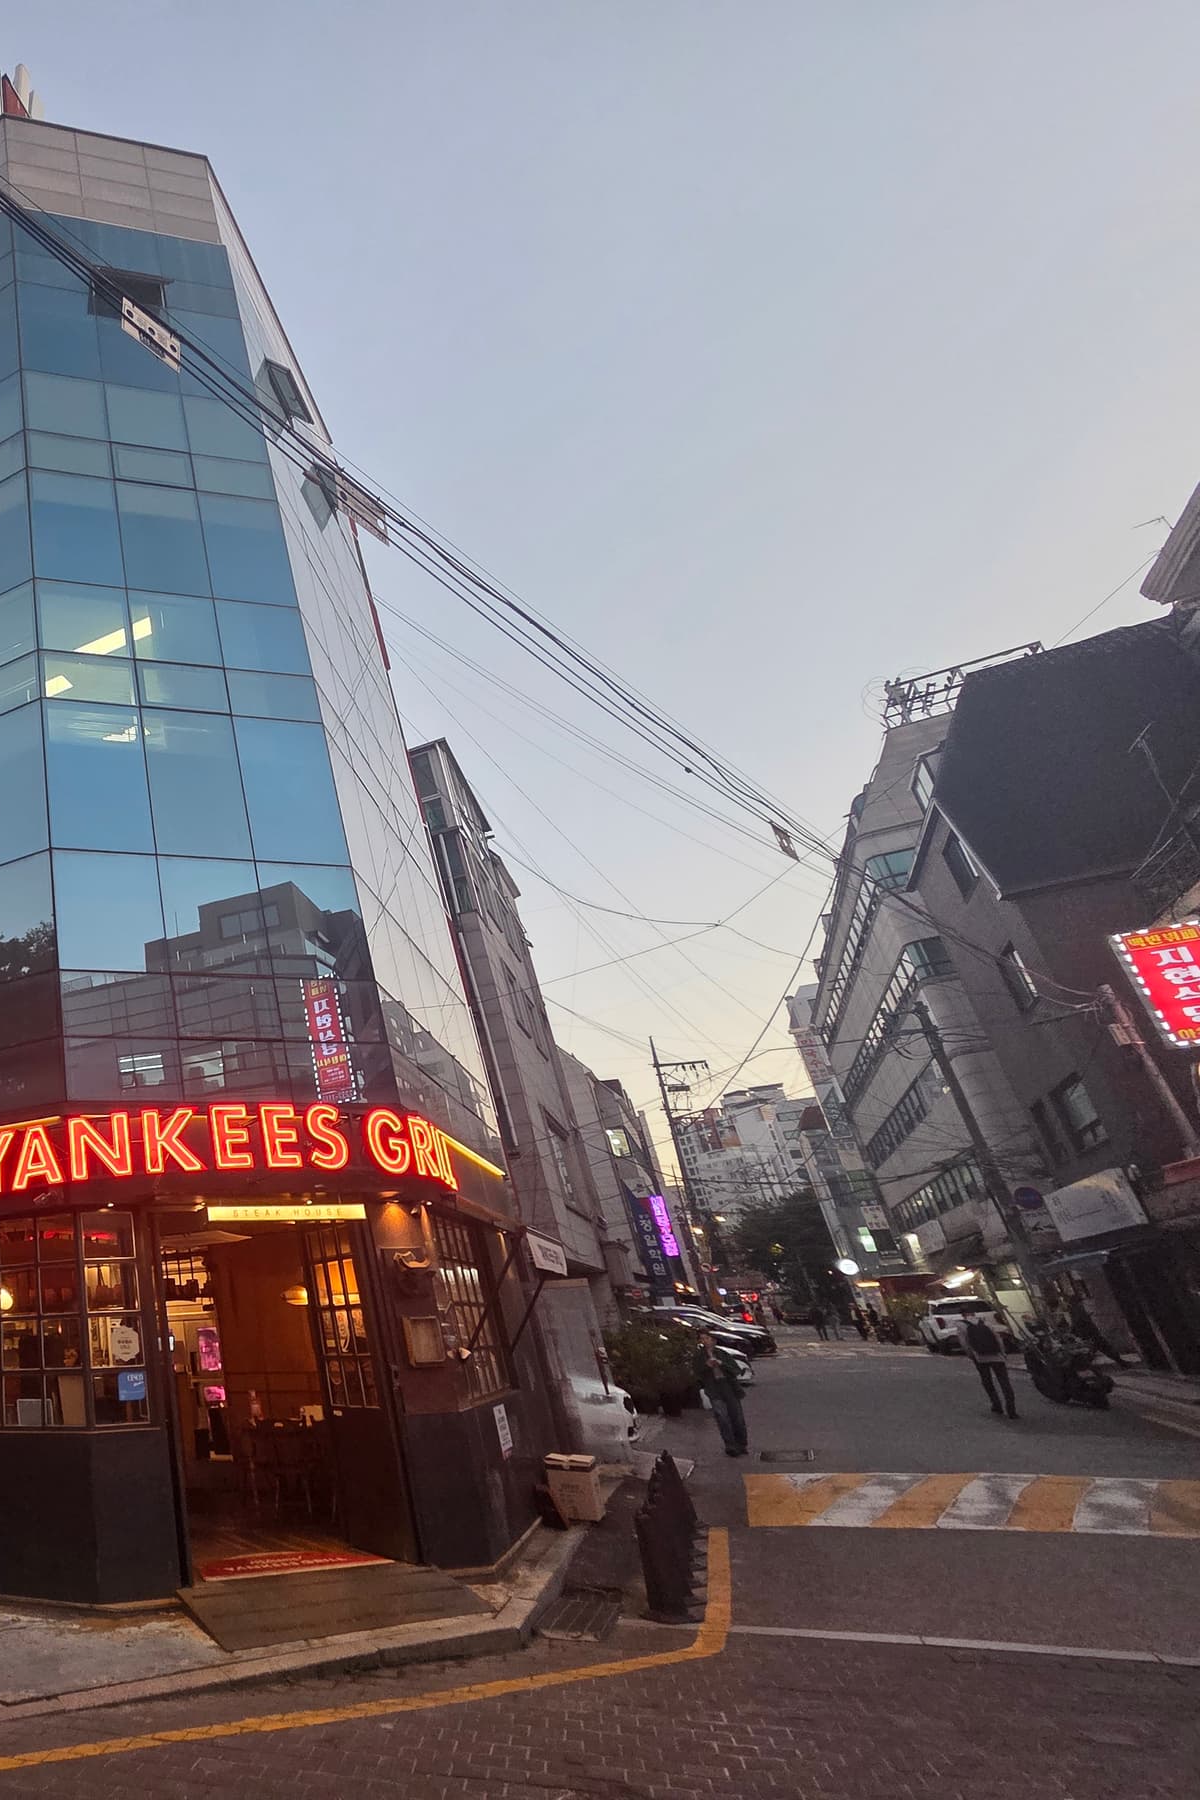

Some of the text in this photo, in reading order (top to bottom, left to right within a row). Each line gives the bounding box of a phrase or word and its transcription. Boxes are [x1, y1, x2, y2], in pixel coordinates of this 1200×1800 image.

[365, 1107, 460, 1193] GRILL
[233, 1207, 343, 1218] STEAK HOUSE
